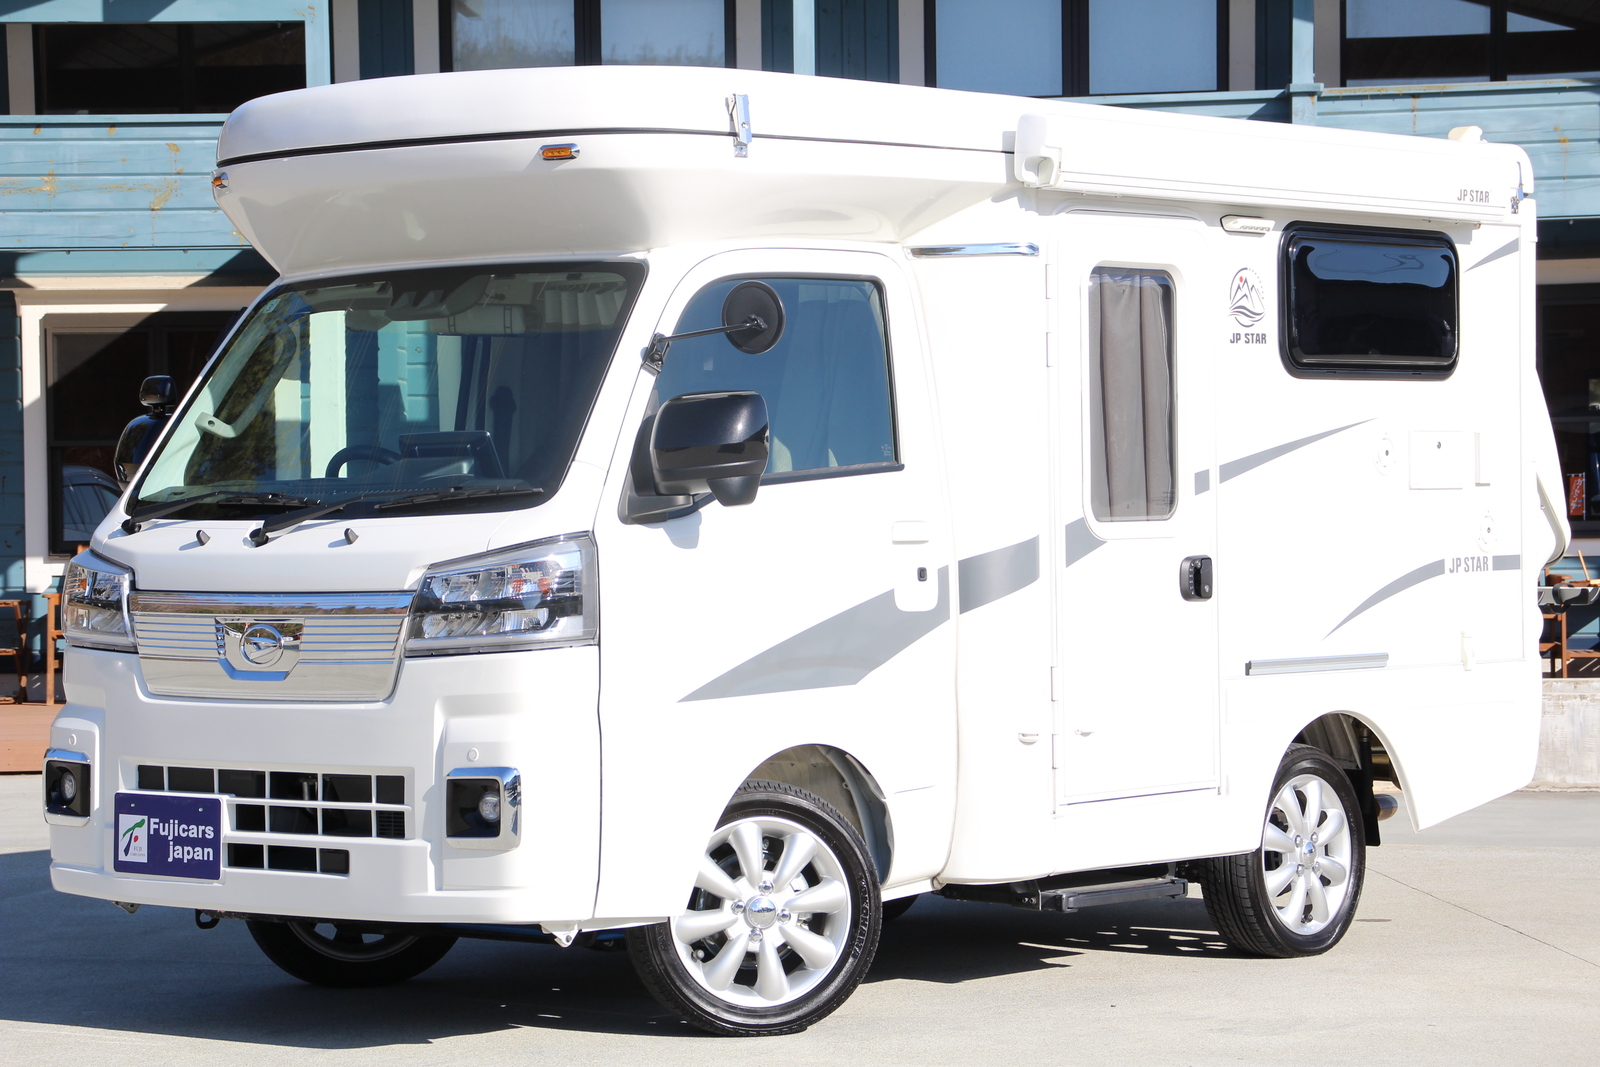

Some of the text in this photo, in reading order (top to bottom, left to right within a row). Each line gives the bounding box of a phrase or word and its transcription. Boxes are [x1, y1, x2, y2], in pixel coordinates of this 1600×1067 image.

[1457, 188, 1490, 203] JP STAR
[1229, 332, 1267, 344] JP STAR
[1449, 555, 1489, 574] JP STAR
[149, 817, 214, 840] Fujicars
[167, 841, 213, 863] japan
